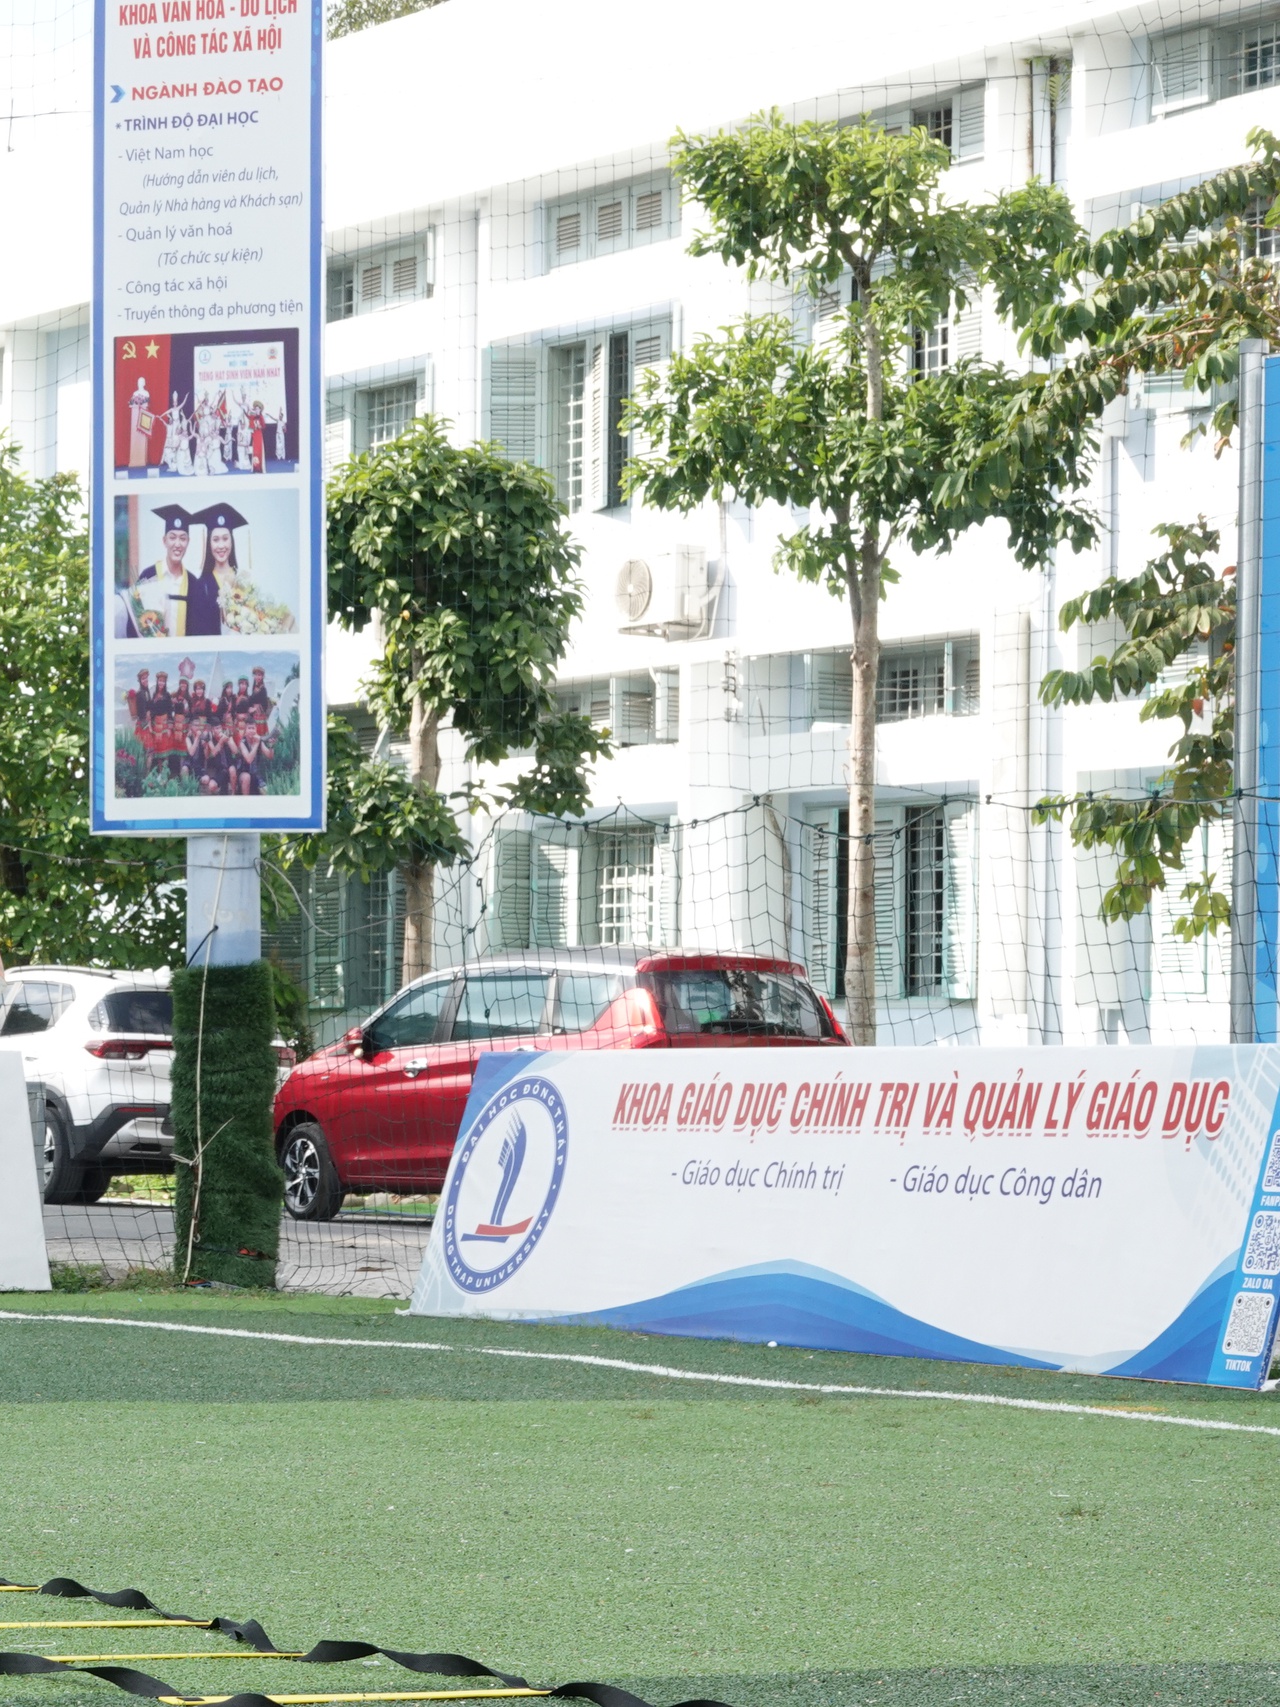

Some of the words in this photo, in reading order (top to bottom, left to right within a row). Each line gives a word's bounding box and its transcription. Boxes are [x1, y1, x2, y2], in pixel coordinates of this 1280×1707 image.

[119, 3, 157, 26] KHOA
[240, 0, 260, 17] DU
[264, 0, 297, 20] LỊCH
[133, 33, 151, 59] VÀ
[157, 31, 196, 58] CÔNG
[201, 28, 228, 54] TÁC
[233, 26, 252, 52] XÃ
[257, 23, 282, 55] HỘI
[131, 81, 198, 101] NGÀNH
[203, 77, 242, 96] ĐÀO
[248, 77, 284, 95] TẠO
[124, 114, 168, 131] TRÌNH
[171, 112, 194, 131] ĐỘ
[197, 113, 223, 130] ĐẠI
[227, 110, 259, 128] HỌC
[125, 147, 151, 164] Việt
[154, 147, 185, 160] Nam
[189, 144, 214, 160] học
[187, 168, 209, 185] dẫn
[212, 169, 236, 183] viên
[238, 167, 253, 182] du
[119, 200, 150, 216] Quản
[152, 200, 163, 216] lý
[165, 199, 189, 213] Nhà
[191, 197, 221, 213] hàng
[224, 196, 237, 209] và
[239, 193, 276, 208] Khách
[278, 192, 304, 207] sạn)
[125, 226, 162, 242] Quản
[165, 225, 177, 242] lý
[180, 224, 204, 238] văn
[207, 223, 233, 237] hoá
[181, 249, 211, 265] chức
[214, 251, 231, 265] sự
[231, 247, 263, 264] kiện)
[125, 280, 161, 296] Công
[164, 278, 184, 293] tác
[188, 277, 203, 291] xã
[207, 276, 228, 292] hội
[168, 304, 205, 320] thông
[208, 303, 224, 316] đa
[227, 301, 276, 318] phương
[279, 299, 304, 315] tiện
[612, 1082, 673, 1130] KHOA
[676, 1071, 733, 1130] GIÁO
[733, 1081, 787, 1141] DỤC
[789, 1071, 872, 1131] CHÍNH
[873, 1082, 919, 1143] TRỊ
[922, 1070, 959, 1132] VÀ
[963, 1068, 1043, 1137] QUẢN
[1043, 1069, 1087, 1134] LÝ
[1086, 1069, 1159, 1137] GIÁO
[1161, 1080, 1230, 1148] DỤC
[682, 1159, 721, 1187] Giáo
[724, 1159, 760, 1193] dục
[763, 1161, 818, 1190] Chính
[822, 1163, 846, 1197] trị
[903, 1164, 949, 1194] Giáo
[954, 1165, 995, 1201] dục
[999, 1166, 1056, 1205] Công
[1061, 1167, 1102, 1199] dân
[475, 1210, 550, 1289] UNIVERSITY
[1242, 1277, 1261, 1289] ZALO
[1263, 1278, 1273, 1290] OA
[1225, 1359, 1252, 1372] TIKTOK
